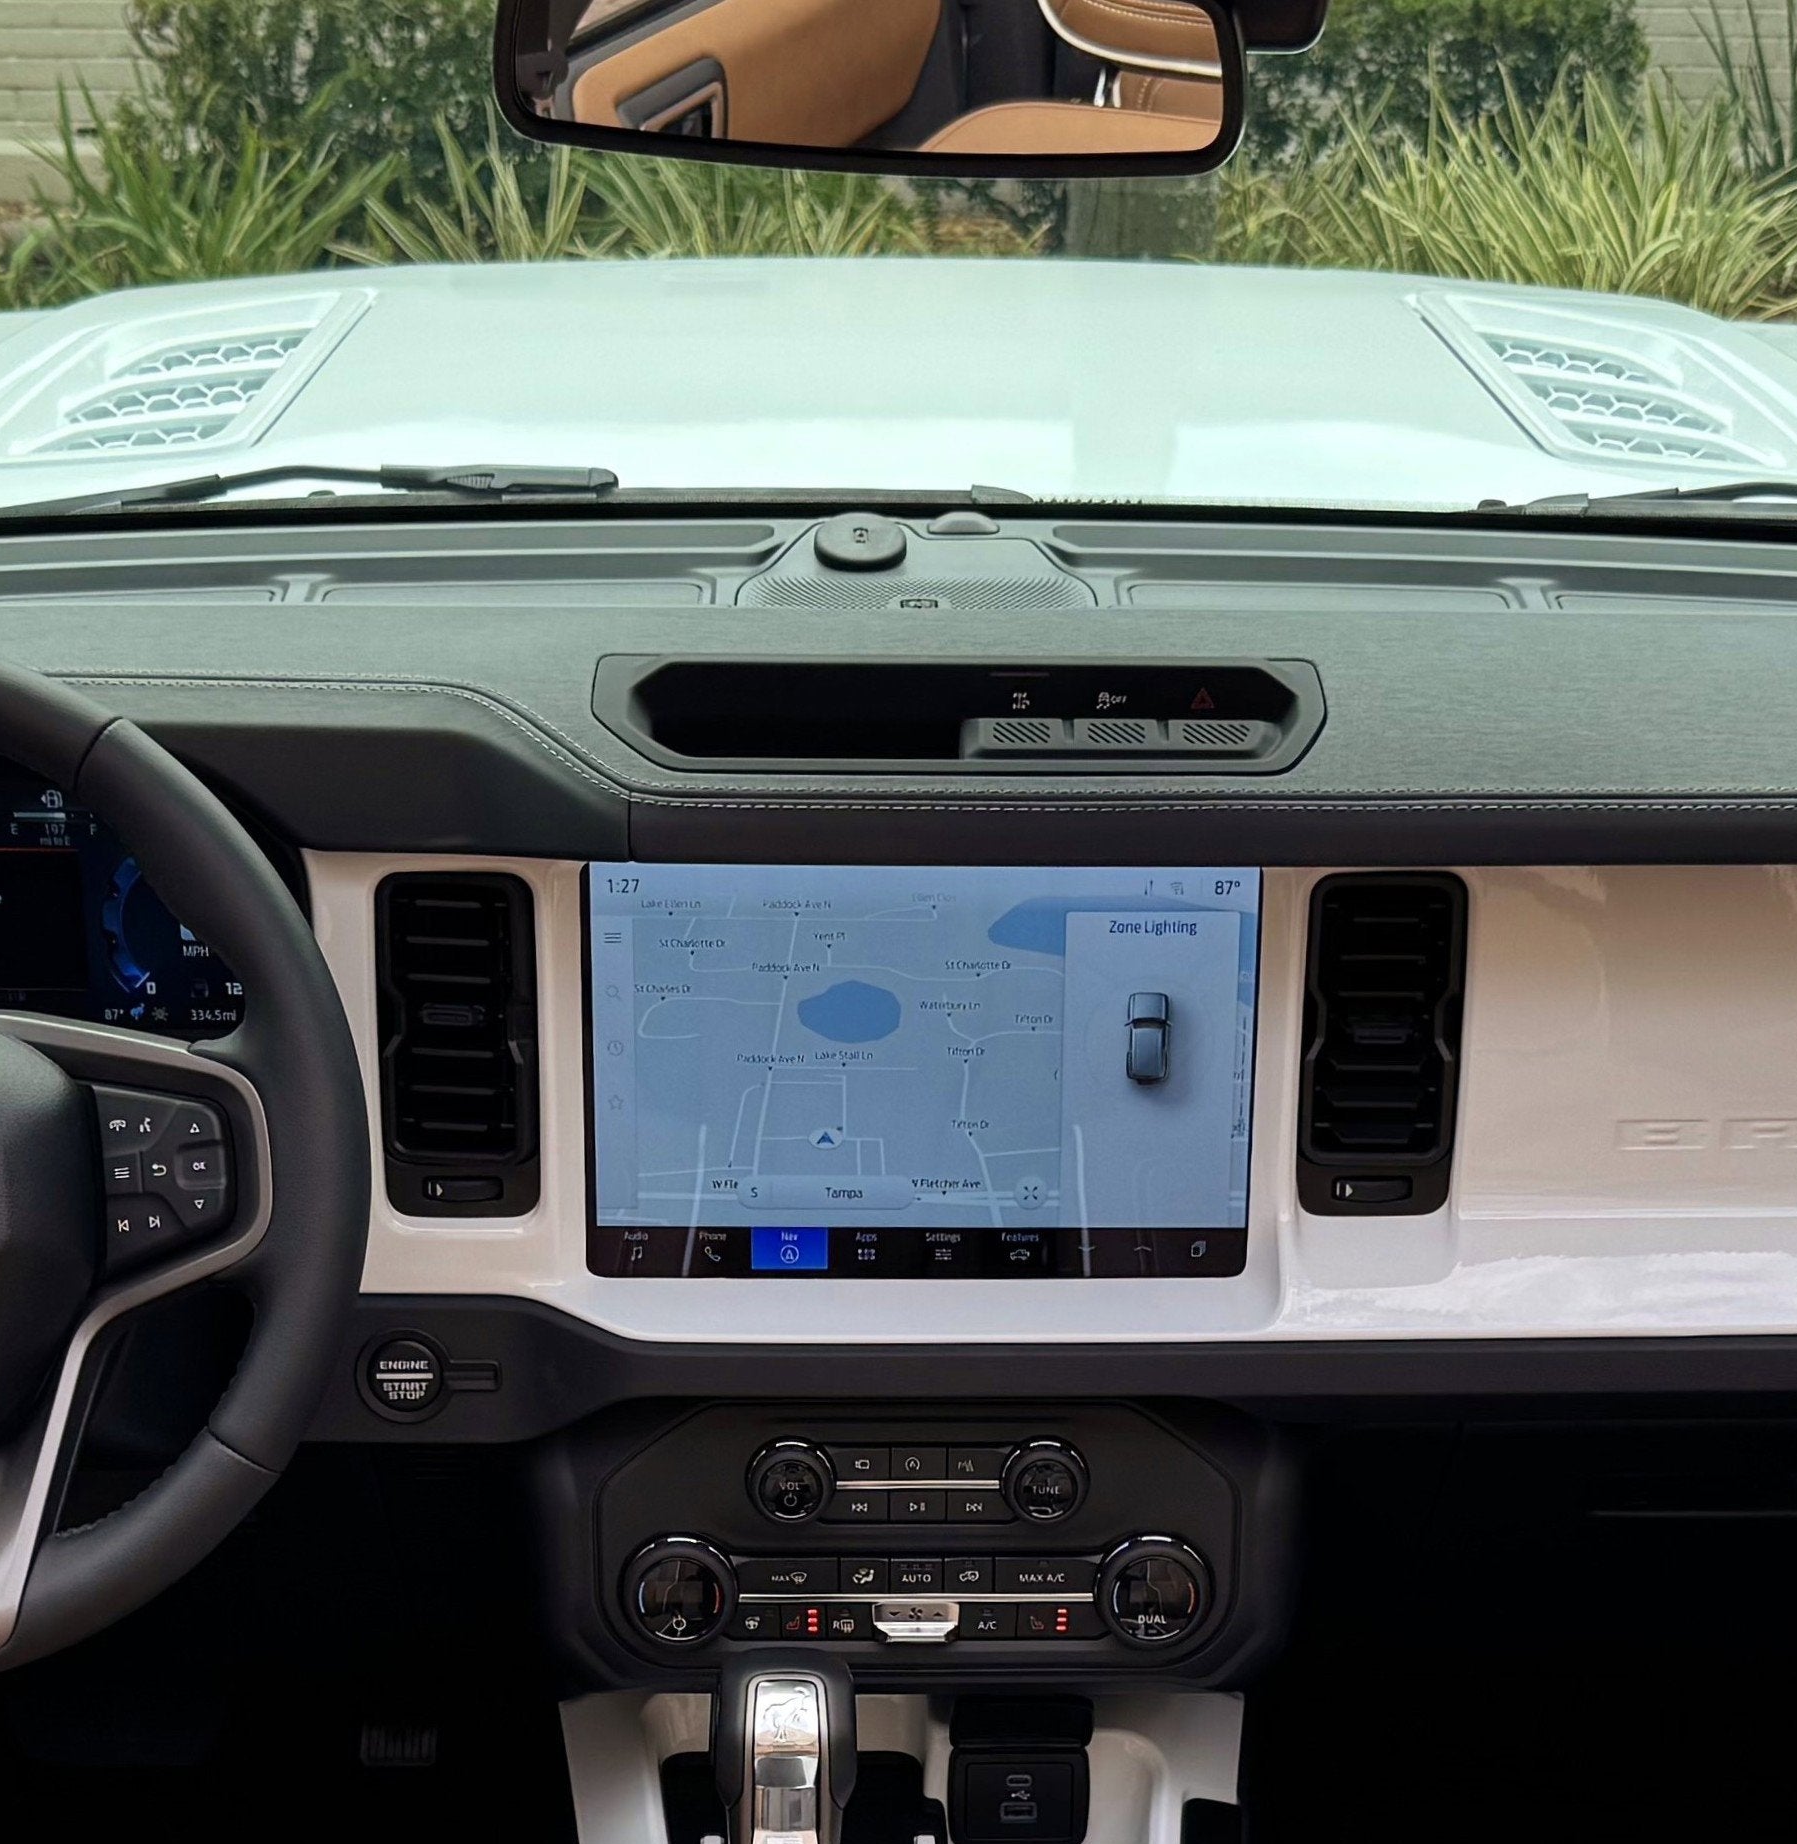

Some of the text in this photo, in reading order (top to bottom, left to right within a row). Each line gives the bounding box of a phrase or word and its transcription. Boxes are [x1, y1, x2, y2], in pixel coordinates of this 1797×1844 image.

[10, 823, 19, 835] E
[607, 878, 640, 894] 1:27
[1214, 880, 1241, 895] 87°
[1109, 920, 1197, 936] Zone Lighting
[182, 945, 210, 958] MPH
[815, 1050, 837, 1061] Lake
[751, 1187, 758, 1198] S
[825, 1187, 863, 1201] Tampa
[624, 1231, 649, 1241] Audio
[699, 1232, 727, 1241] Phone
[925, 1232, 961, 1243] Settings
[1001, 1232, 1039, 1241] Features
[379, 1360, 429, 1370] ENGINE
[383, 1382, 429, 1392] START
[389, 1391, 425, 1400] STOP
[779, 1481, 801, 1491] VOL
[1032, 1485, 1061, 1495] TUNE
[901, 1572, 932, 1583] AUTO
[1019, 1572, 1065, 1584] MAX A/C
[1137, 1614, 1167, 1625] DUAL
[977, 1620, 997, 1631] A/C
